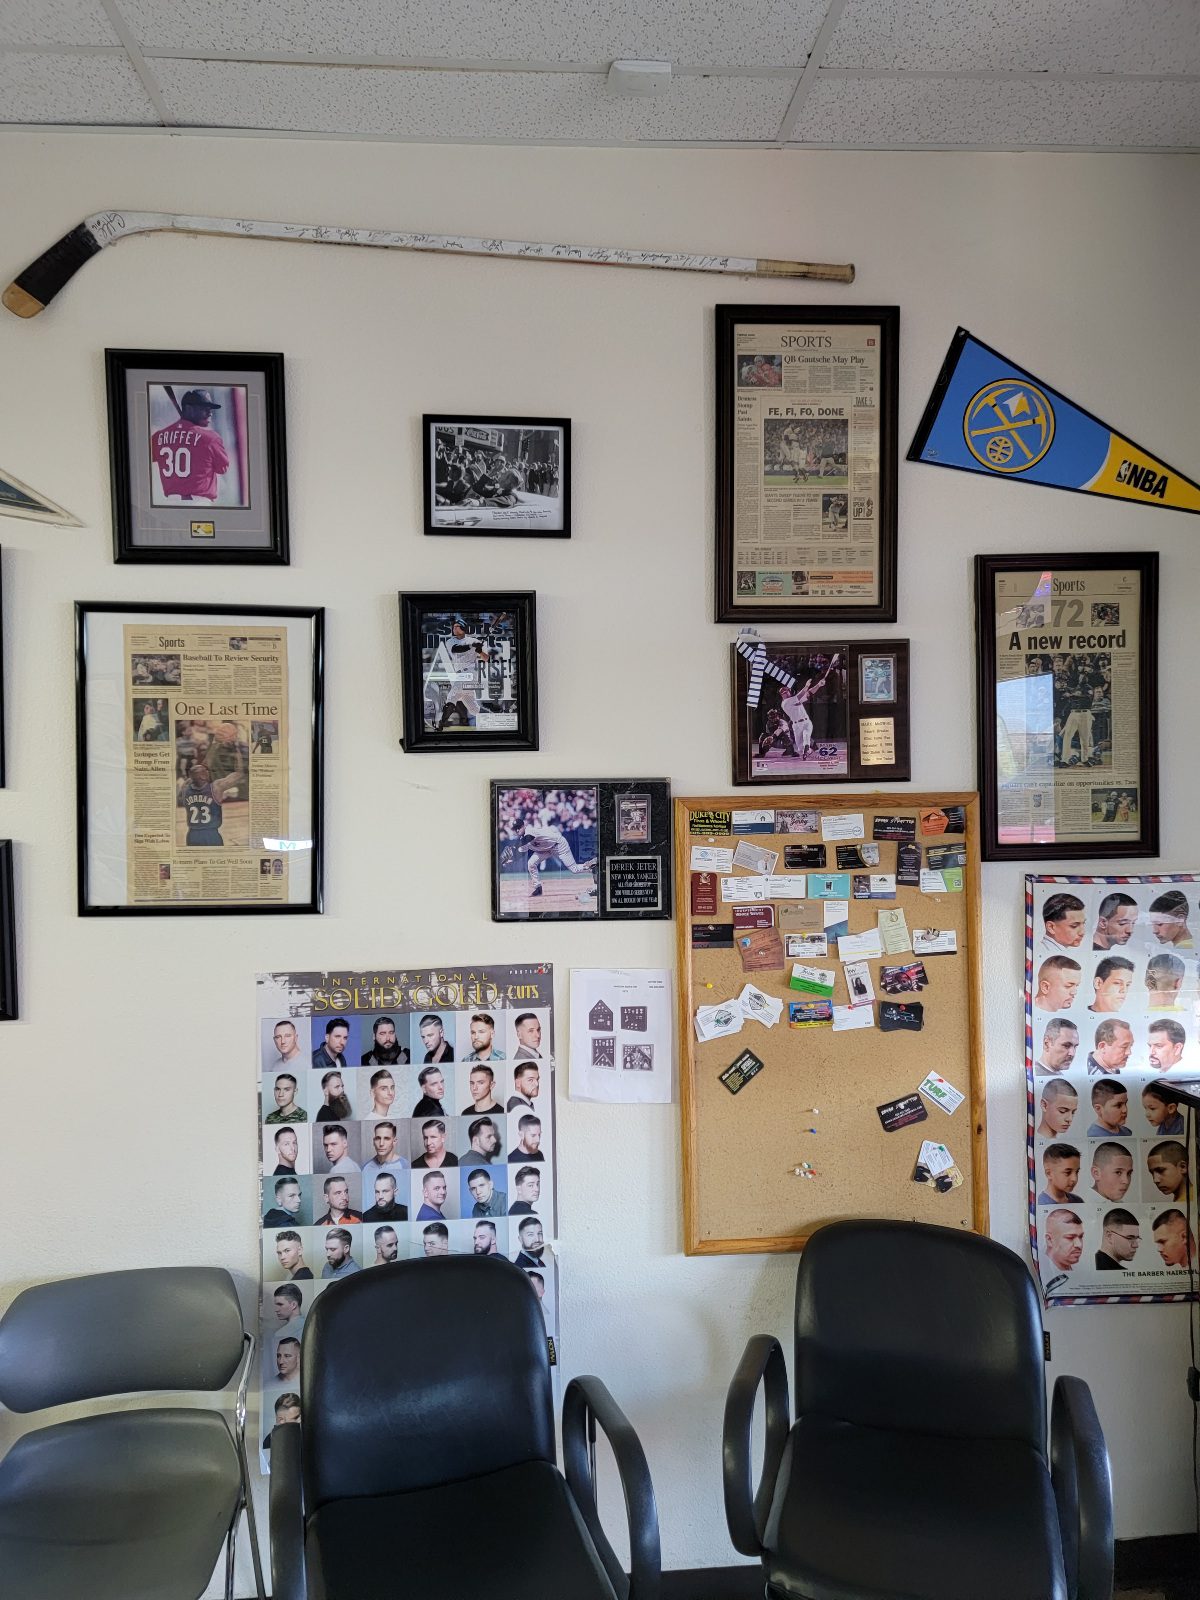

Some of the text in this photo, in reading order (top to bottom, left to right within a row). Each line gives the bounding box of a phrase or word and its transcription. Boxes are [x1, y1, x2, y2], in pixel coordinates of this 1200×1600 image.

[780, 336, 832, 347] SPORTS
[784, 356, 796, 364] QB
[832, 356, 848, 365] May
[850, 356, 866, 364] Play
[768, 408, 844, 417] FE, FI, FO, DONE
[157, 430, 202, 447] GRIFFEY
[159, 447, 191, 478] 30
[1128, 464, 1169, 498] NBA
[1053, 578, 1086, 594] Sports
[1051, 599, 1084, 627] 72
[158, 636, 185, 650] Sports
[1009, 630, 1126, 650] A new record
[182, 654, 212, 662] Baseball
[250, 655, 279, 664] Security
[478, 659, 512, 681] RISE!
[175, 702, 278, 716] One Last Time
[819, 747, 838, 756] 62
[1076, 780, 1114, 788] opportunities
[186, 794, 212, 805] JORDAN
[190, 806, 212, 824] 23
[715, 811, 731, 822] CITY
[636, 862, 656, 870] JETER
[636, 872, 658, 880] YANKEES
[322, 972, 490, 986] INTERNATIONAL
[313, 982, 540, 1011] SOLID GOLD CUTS
[922, 1078, 948, 1100] TURF
